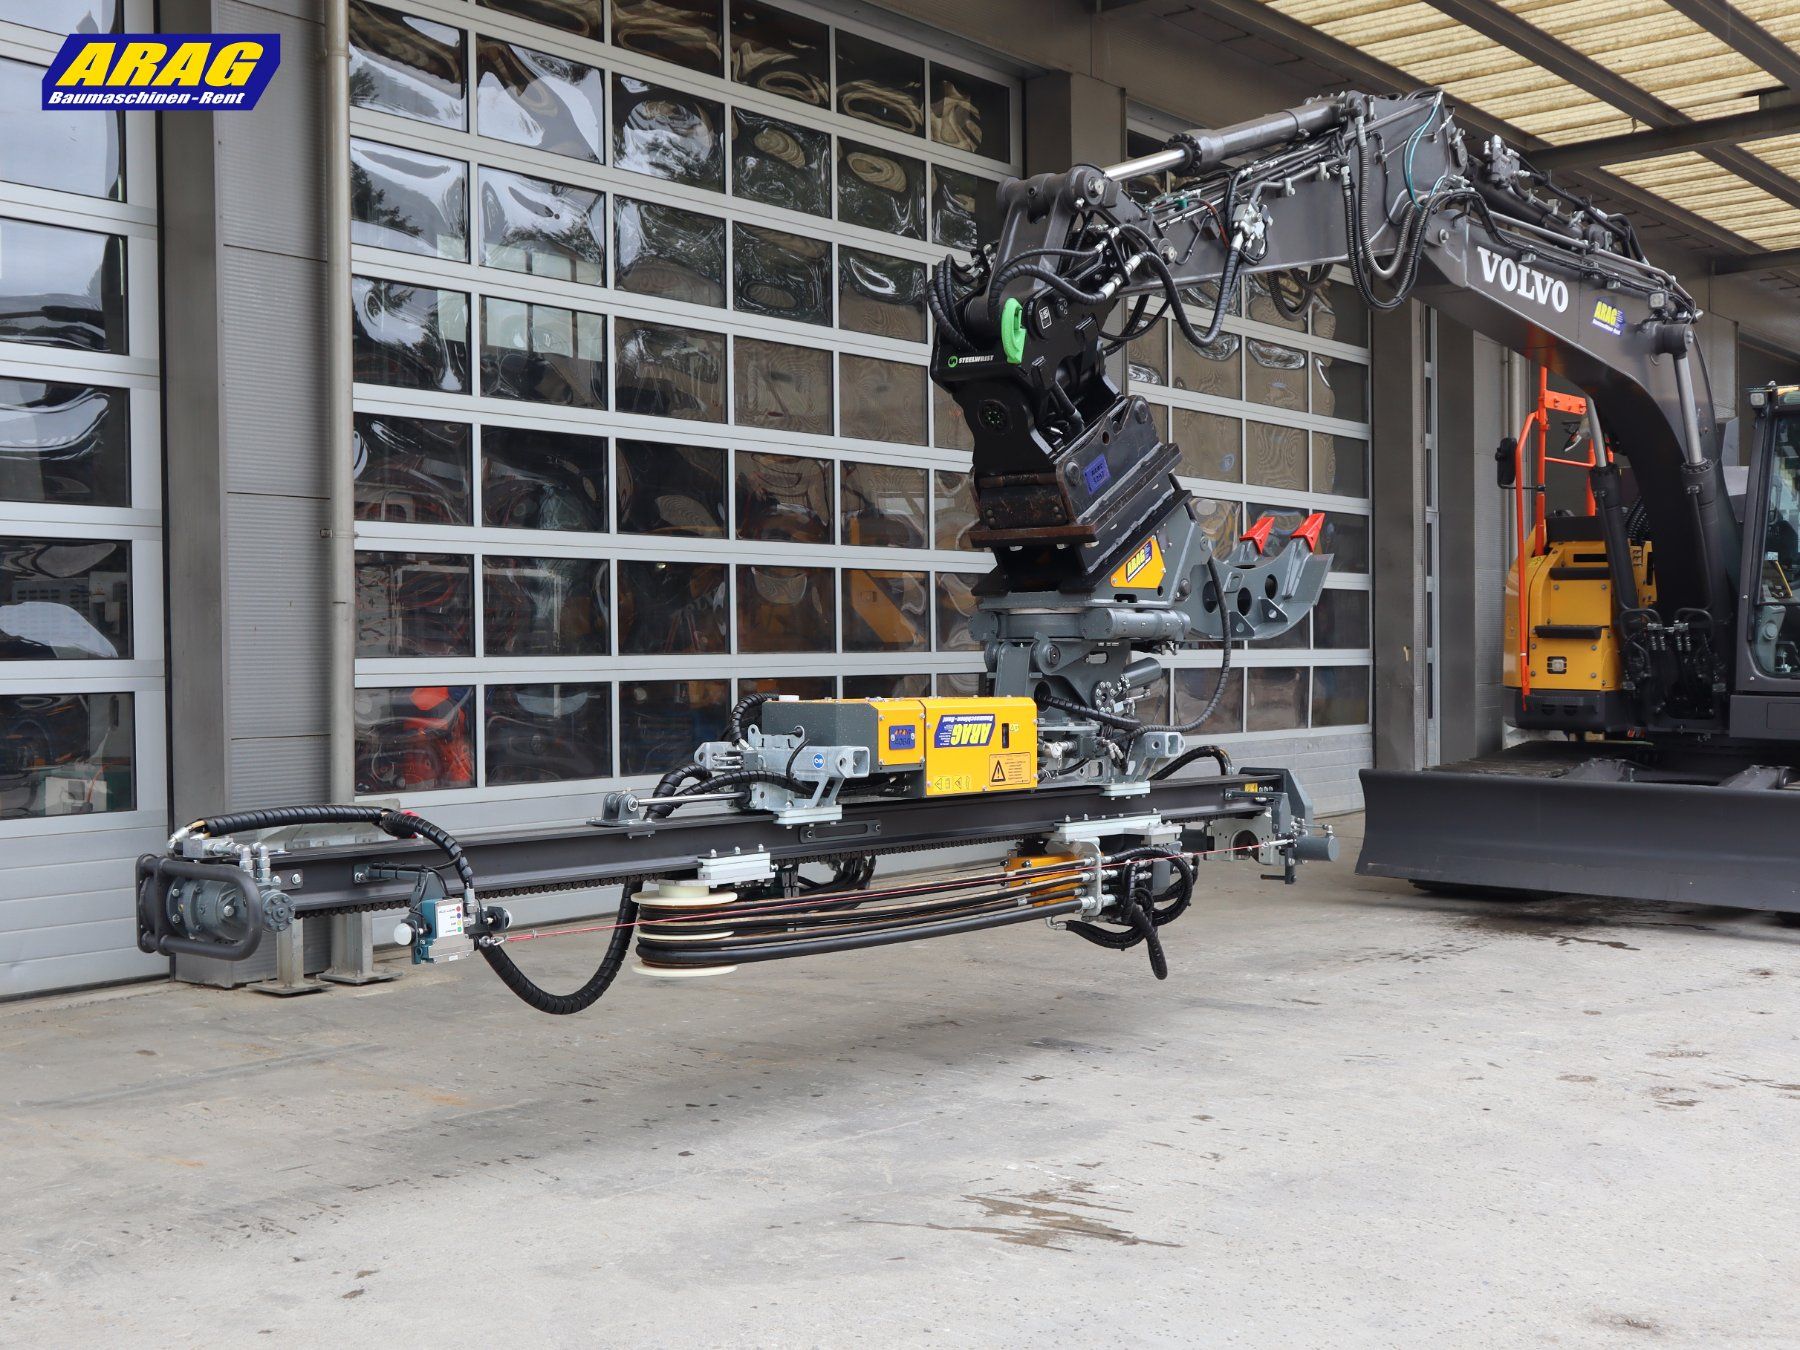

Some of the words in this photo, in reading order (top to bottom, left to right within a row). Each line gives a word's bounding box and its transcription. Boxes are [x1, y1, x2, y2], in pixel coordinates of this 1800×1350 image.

[1477, 246, 1569, 313] VOLVO
[1594, 301, 1618, 326] ARAG
[958, 355, 994, 364] STEELWRIST
[951, 723, 993, 746] ARAG
